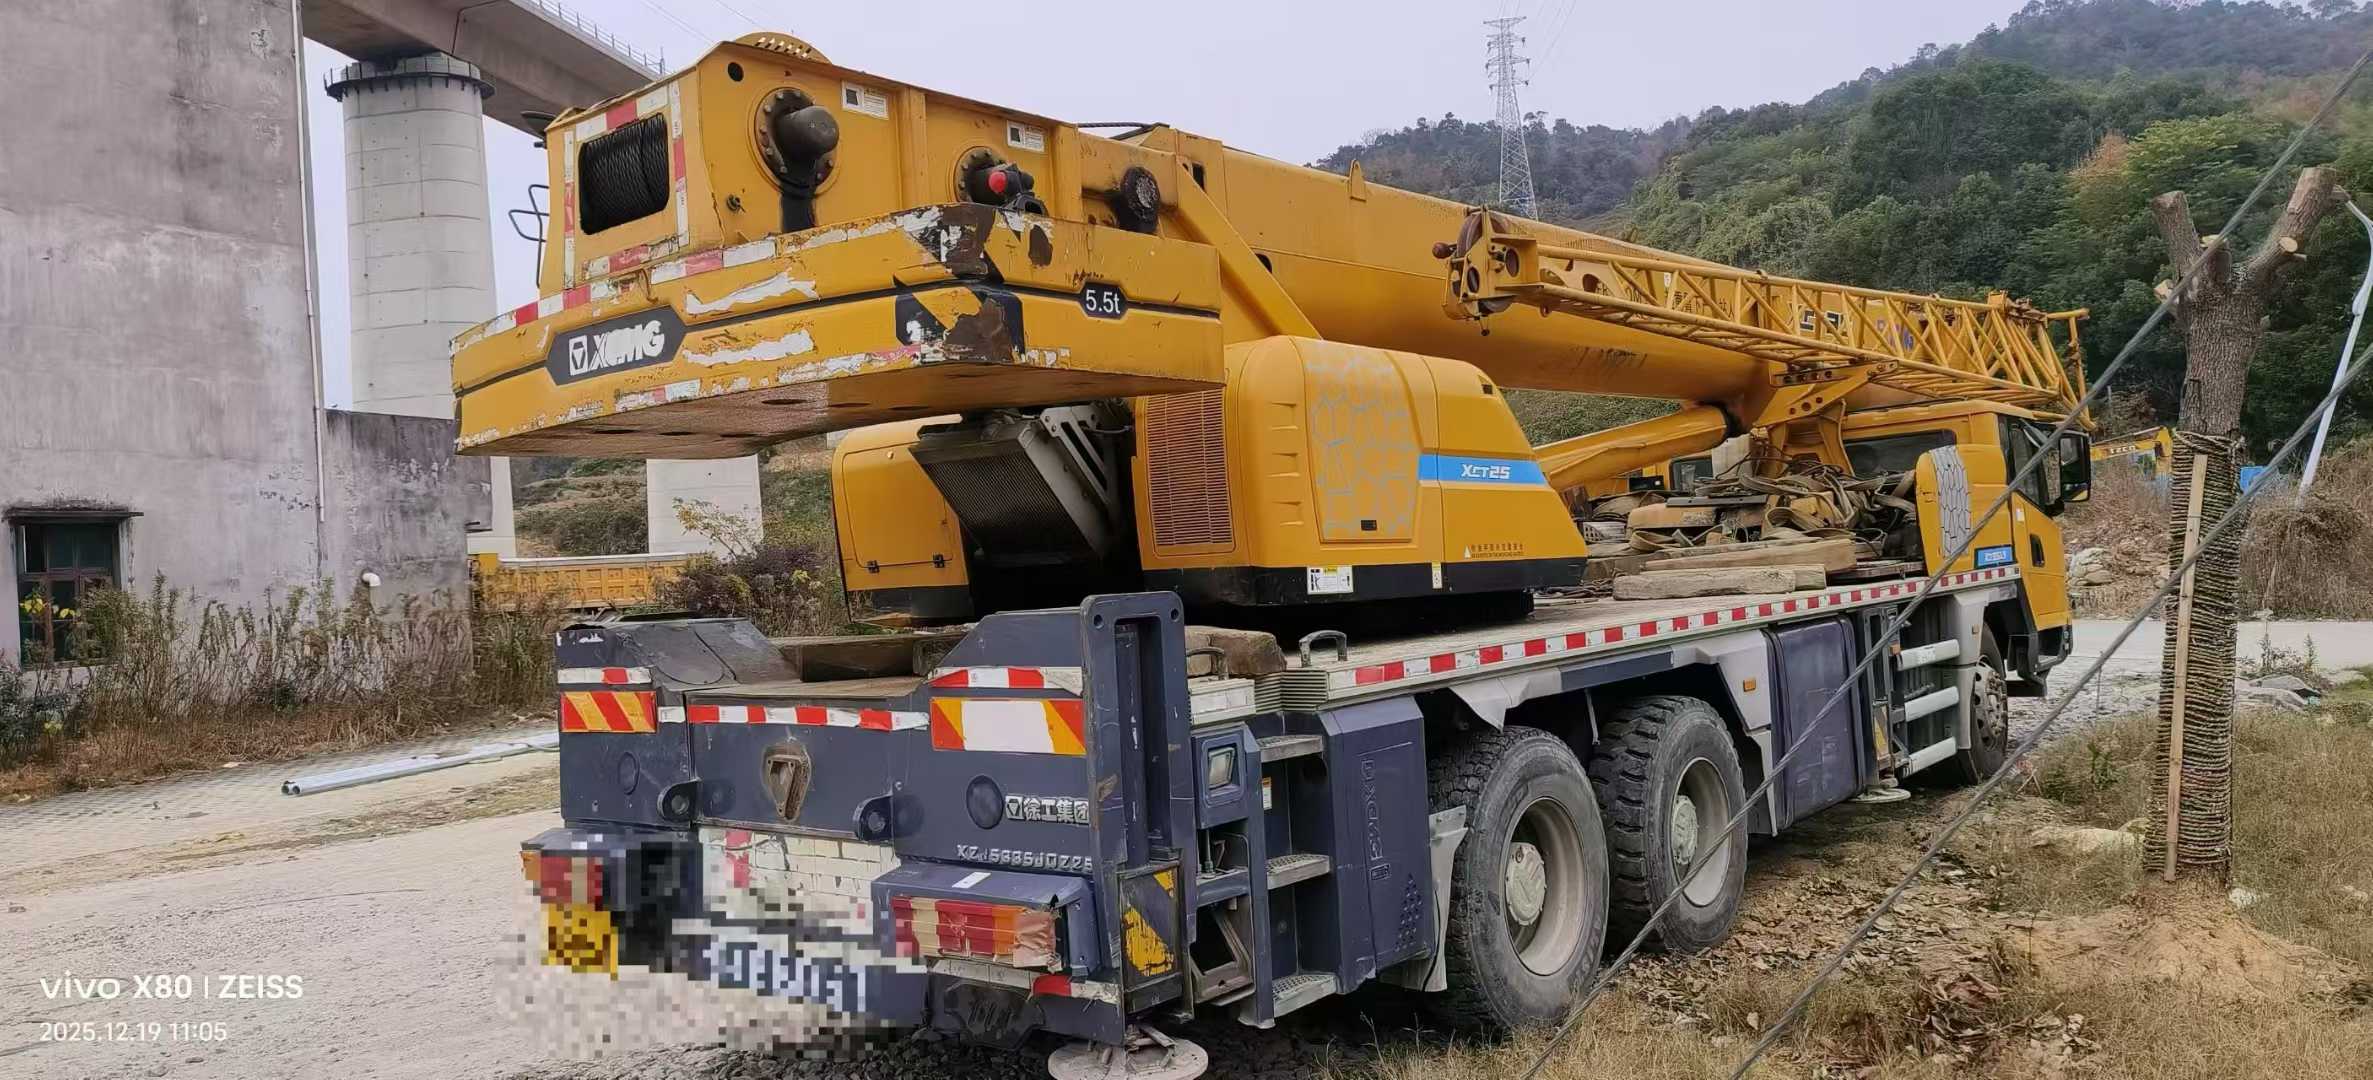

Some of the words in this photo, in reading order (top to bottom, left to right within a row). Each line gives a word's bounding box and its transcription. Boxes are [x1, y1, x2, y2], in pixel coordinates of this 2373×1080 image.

[1086, 289, 1121, 314] 5.5t
[1461, 463, 1511, 479] XCT25
[1023, 796, 1089, 823] 徐工集团
